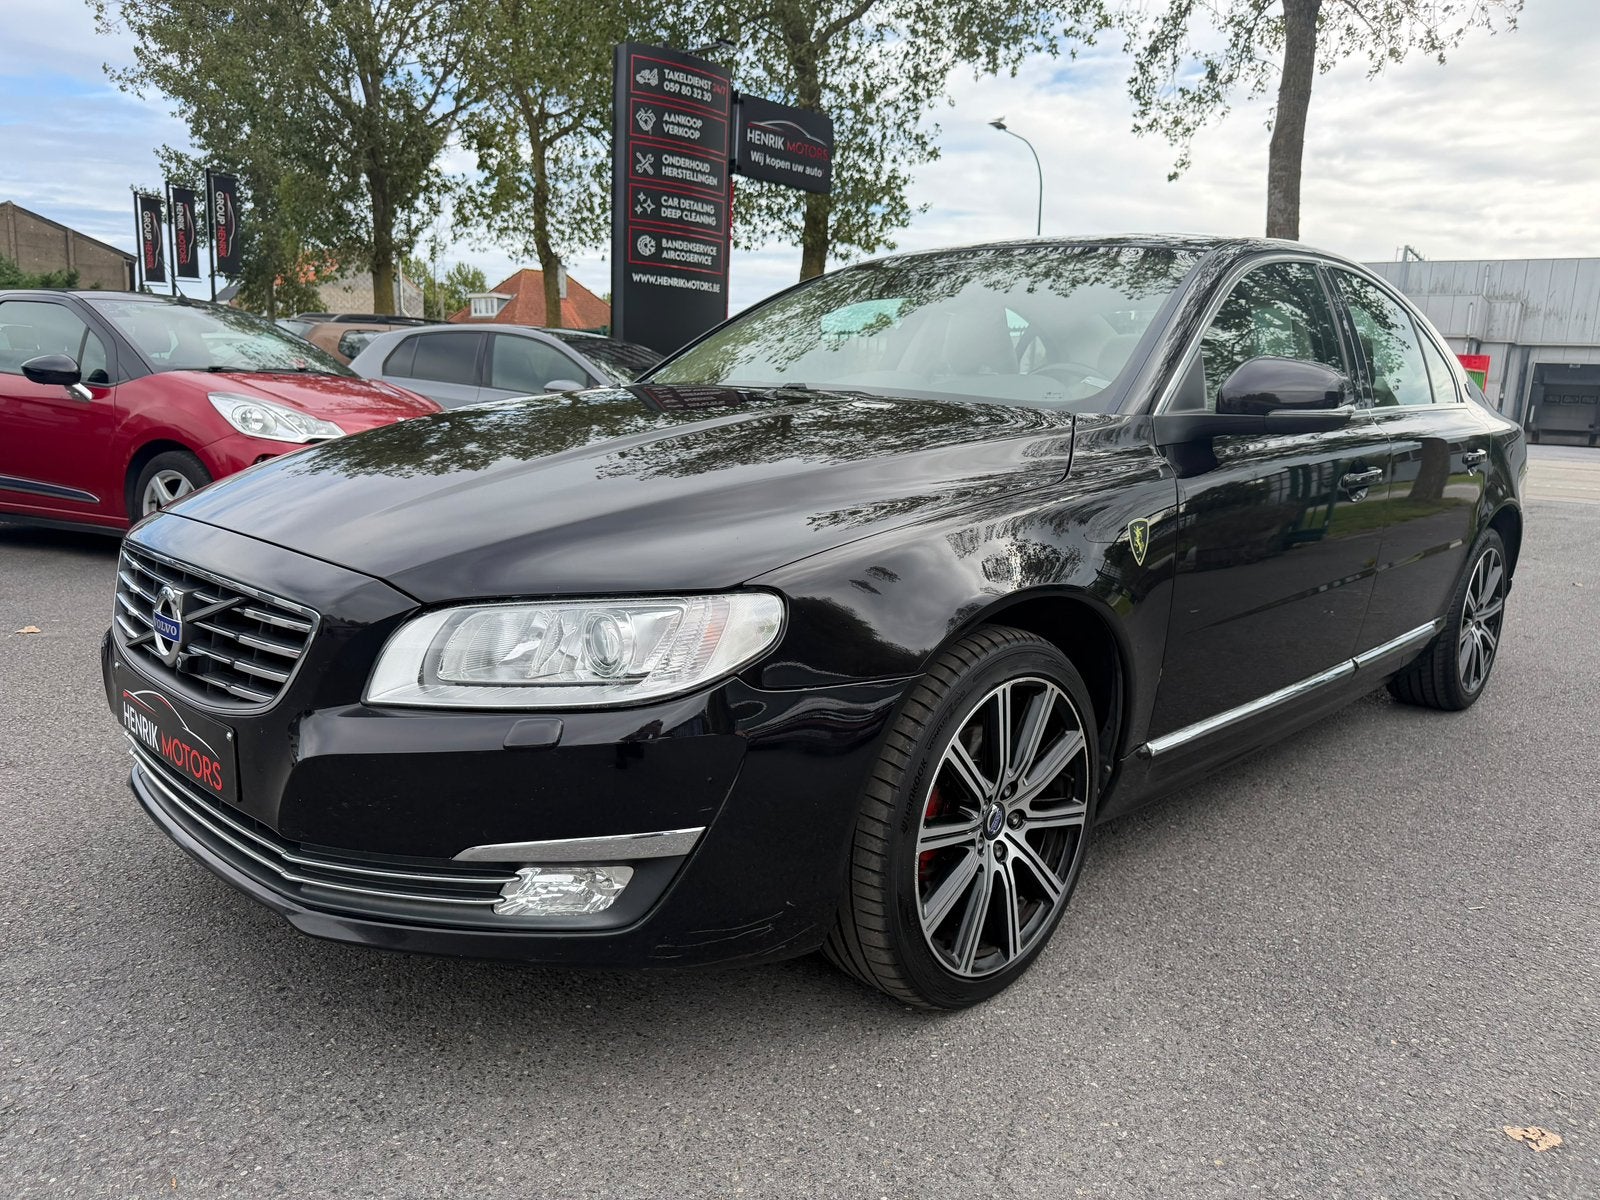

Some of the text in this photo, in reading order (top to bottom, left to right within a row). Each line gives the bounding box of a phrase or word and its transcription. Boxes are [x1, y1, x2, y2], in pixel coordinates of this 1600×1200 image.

[663, 69, 712, 91] TAKELDIENST
[663, 81, 712, 103] 059 80 32 30
[663, 112, 703, 129] AANKOOP
[663, 123, 701, 140] VERKOOP
[746, 128, 829, 161] HENRIK MOTORS
[662, 154, 711, 173] ONDERHOUD
[750, 150, 823, 178] Wij kopen uw auto
[662, 166, 718, 186] HERSTELLINGEN
[661, 196, 715, 215] CAR DETAILING
[215, 191, 228, 257] GROUP HENRIK
[661, 207, 717, 226] DEEP CLEANING
[143, 210, 155, 270] GROUP HENRIK
[176, 202, 188, 264] HENRIK MOTORS
[661, 238, 717, 256] BANDENSERVICE
[661, 250, 712, 265] AIRCOSERVICE
[632, 272, 720, 293] WWW.HENRIKMOTORS.BE
[123, 700, 223, 791] HENRIK MOTORS
